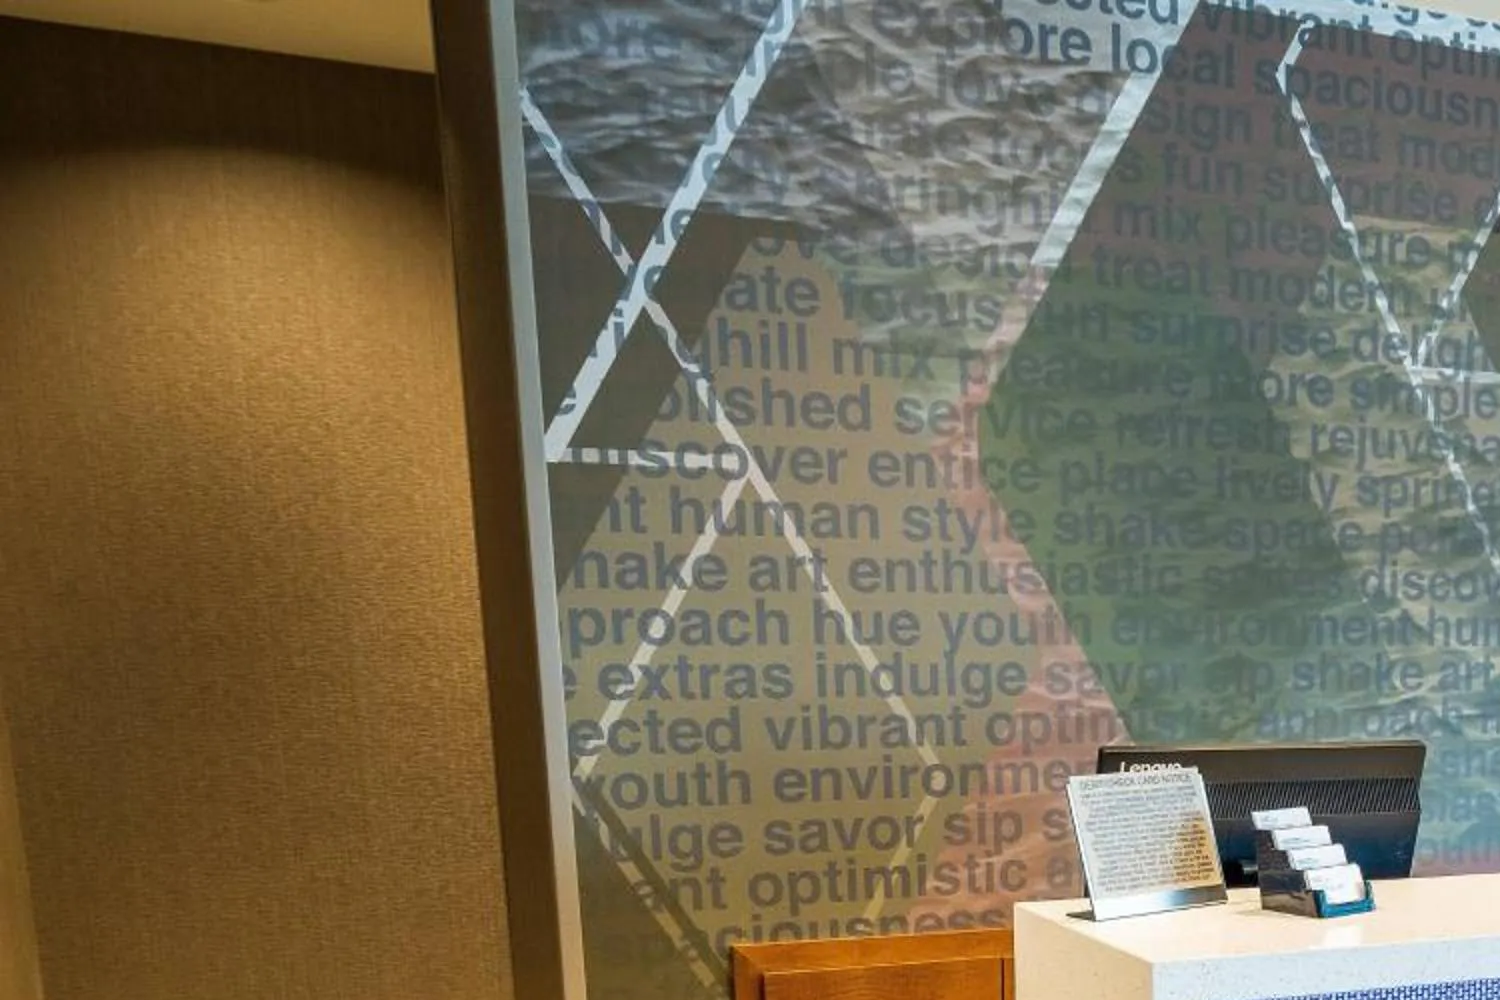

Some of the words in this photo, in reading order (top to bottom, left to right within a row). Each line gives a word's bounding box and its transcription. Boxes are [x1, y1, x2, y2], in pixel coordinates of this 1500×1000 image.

[1111, 23, 1235, 88] local
[894, 395, 1098, 442] service
[868, 443, 1040, 493] entice
[1058, 451, 1198, 507] place
[670, 485, 881, 540] human
[902, 494, 1037, 553] style
[1052, 497, 1204, 552] shake
[748, 549, 829, 592] art
[849, 547, 1182, 597] enthusiastic
[813, 600, 921, 647] hue
[938, 600, 1092, 655] youth
[597, 655, 794, 699] extras
[814, 651, 1027, 708] indulge
[1045, 657, 1186, 697] savor
[1292, 651, 1425, 694] shake
[762, 706, 965, 752] vibrant
[763, 810, 925, 856] savor
[942, 803, 1024, 854] sip
[746, 852, 1028, 915] optimistic
